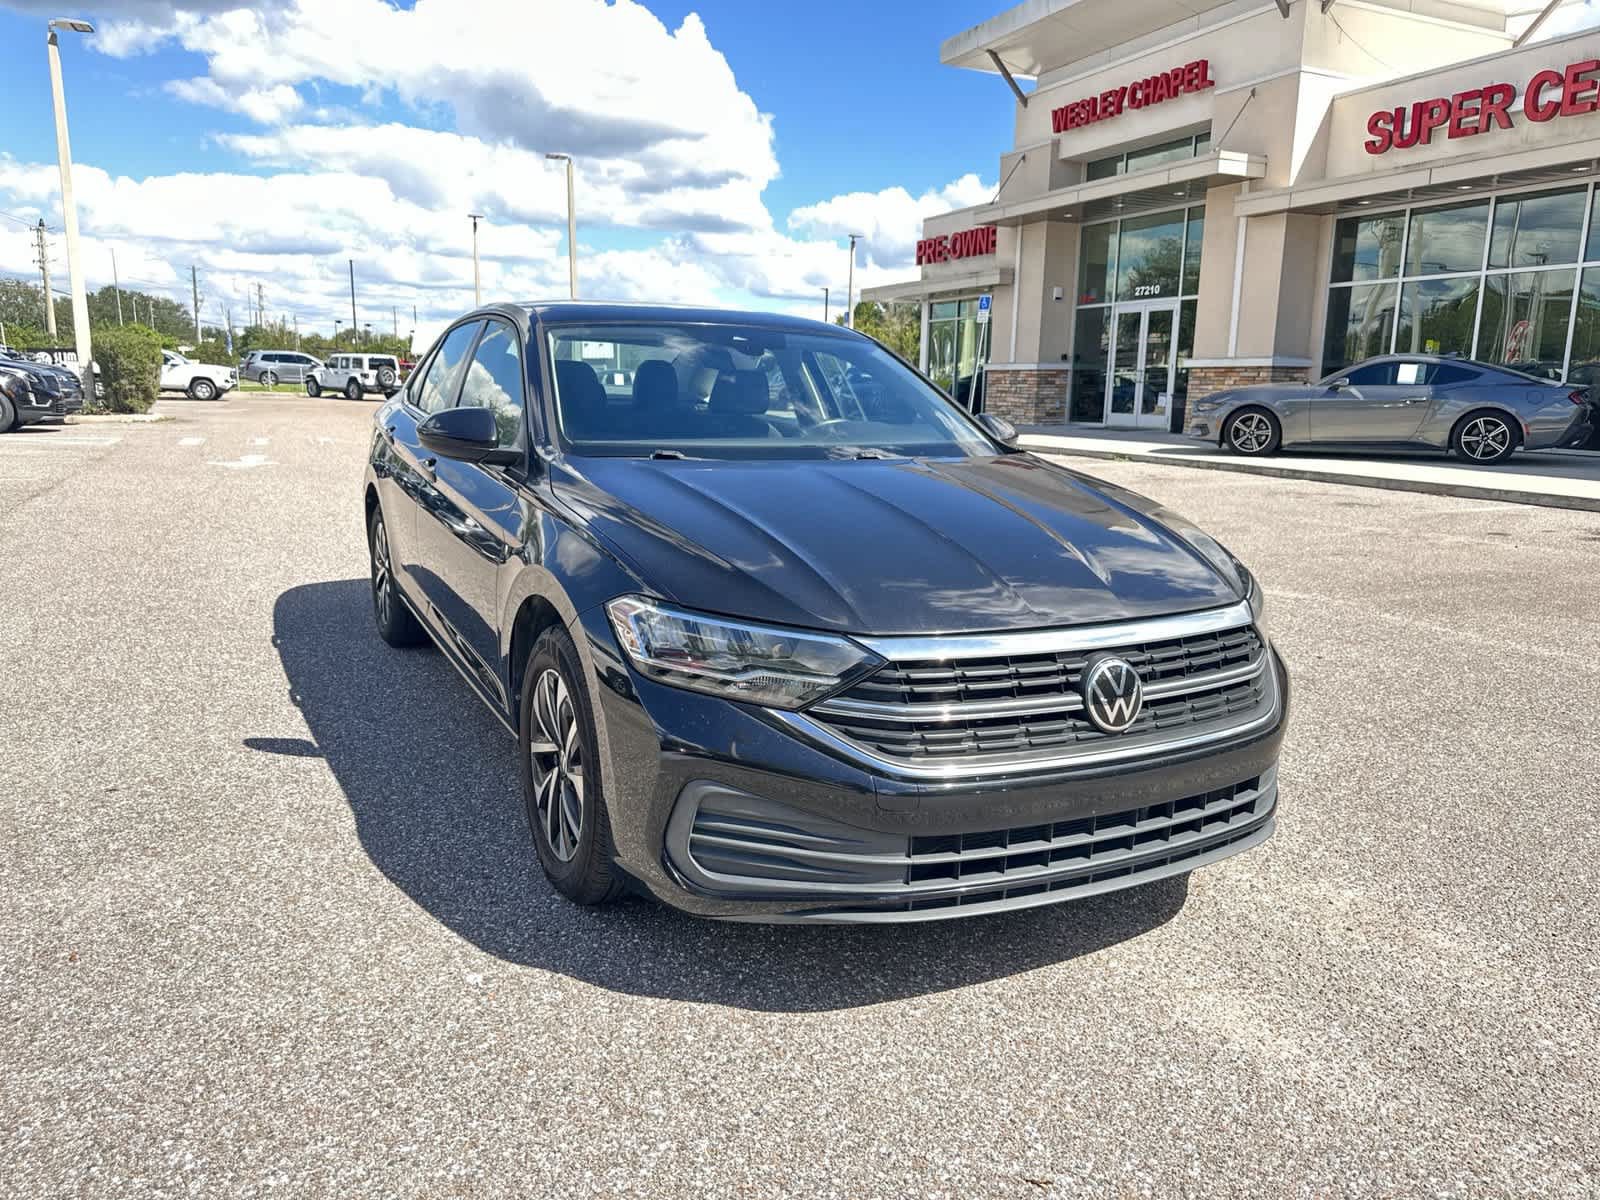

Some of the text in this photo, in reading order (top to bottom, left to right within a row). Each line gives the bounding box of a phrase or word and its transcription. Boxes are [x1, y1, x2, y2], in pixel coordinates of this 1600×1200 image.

[1052, 59, 1215, 133] WESLEY CHAPEL
[1365, 59, 1600, 154] SUPER CE
[1135, 285, 1160, 296] 27210
[1089, 660, 1140, 728] VW
